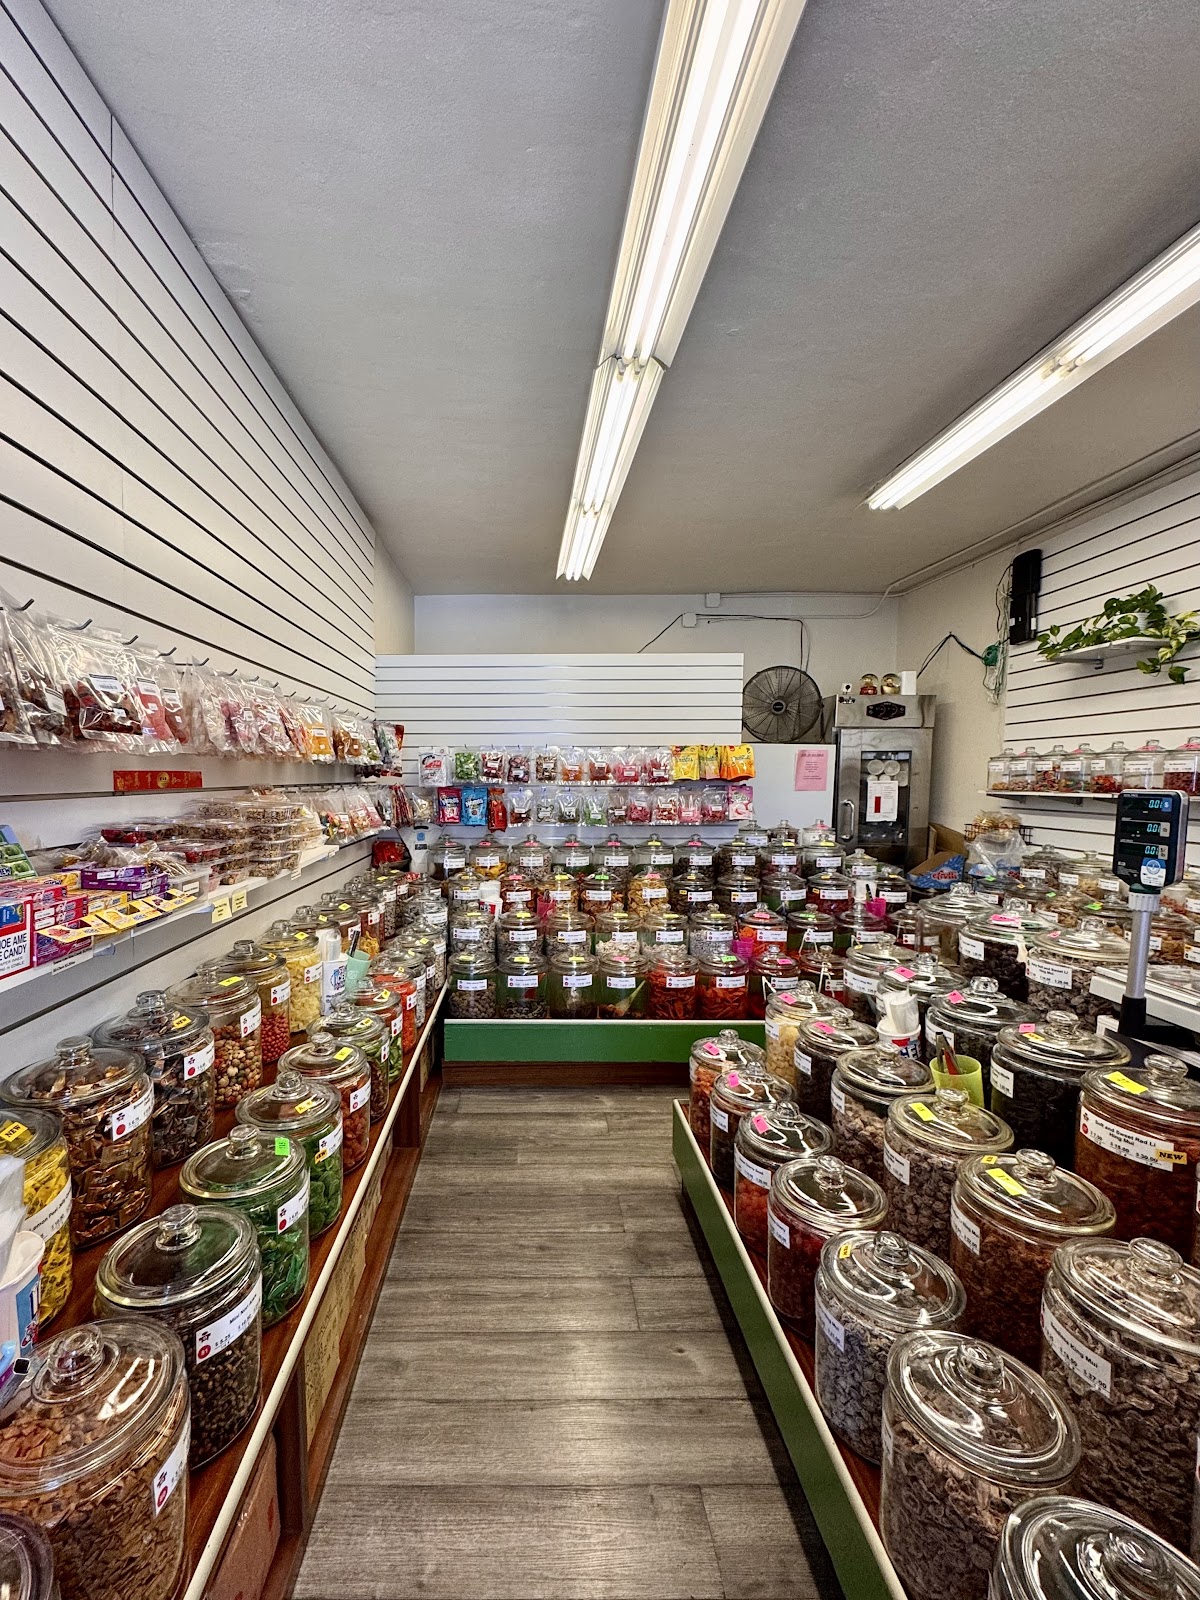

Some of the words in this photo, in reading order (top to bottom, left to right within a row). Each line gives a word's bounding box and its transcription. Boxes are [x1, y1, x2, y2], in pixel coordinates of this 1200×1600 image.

[1147, 823, 1160, 832] 0.0
[932, 870, 958, 881] efrutti
[13, 932, 27, 943] AME
[3, 944, 27, 960] CANDY
[5, 1124, 21, 1138] NEW
[1105, 1124, 1115, 1132] and
[1115, 1127, 1133, 1141] Sweet
[1135, 1136, 1147, 1146] Red
[1109, 1132, 1122, 1143] Hing
[1123, 1138, 1135, 1146] Mui
[1159, 1151, 1184, 1161] NEW
[29, 1217, 48, 1232] Lemon
[229, 1313, 240, 1325] Mini
[1070, 1343, 1084, 1359] King
[1085, 1355, 1098, 1369] Mui
